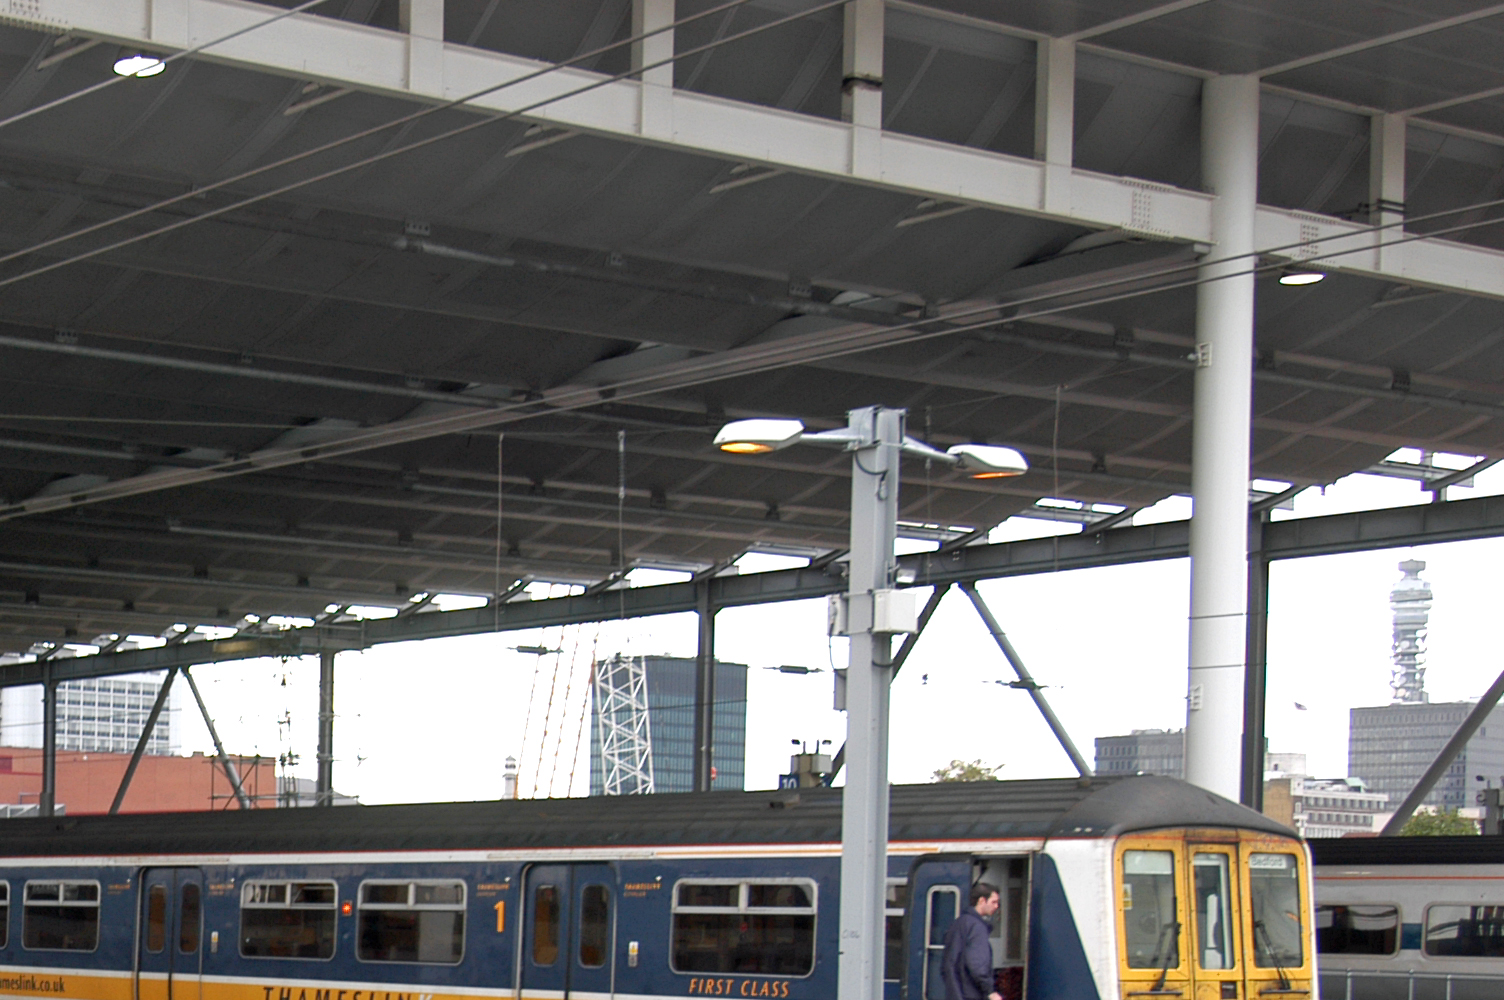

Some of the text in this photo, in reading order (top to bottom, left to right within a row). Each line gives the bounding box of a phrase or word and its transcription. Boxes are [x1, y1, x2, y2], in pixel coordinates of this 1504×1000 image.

[782, 777, 797, 789] 10
[1251, 855, 1283, 866] Bedford
[494, 900, 505, 933] 1
[689, 978, 790, 998] FIRST CLASS
